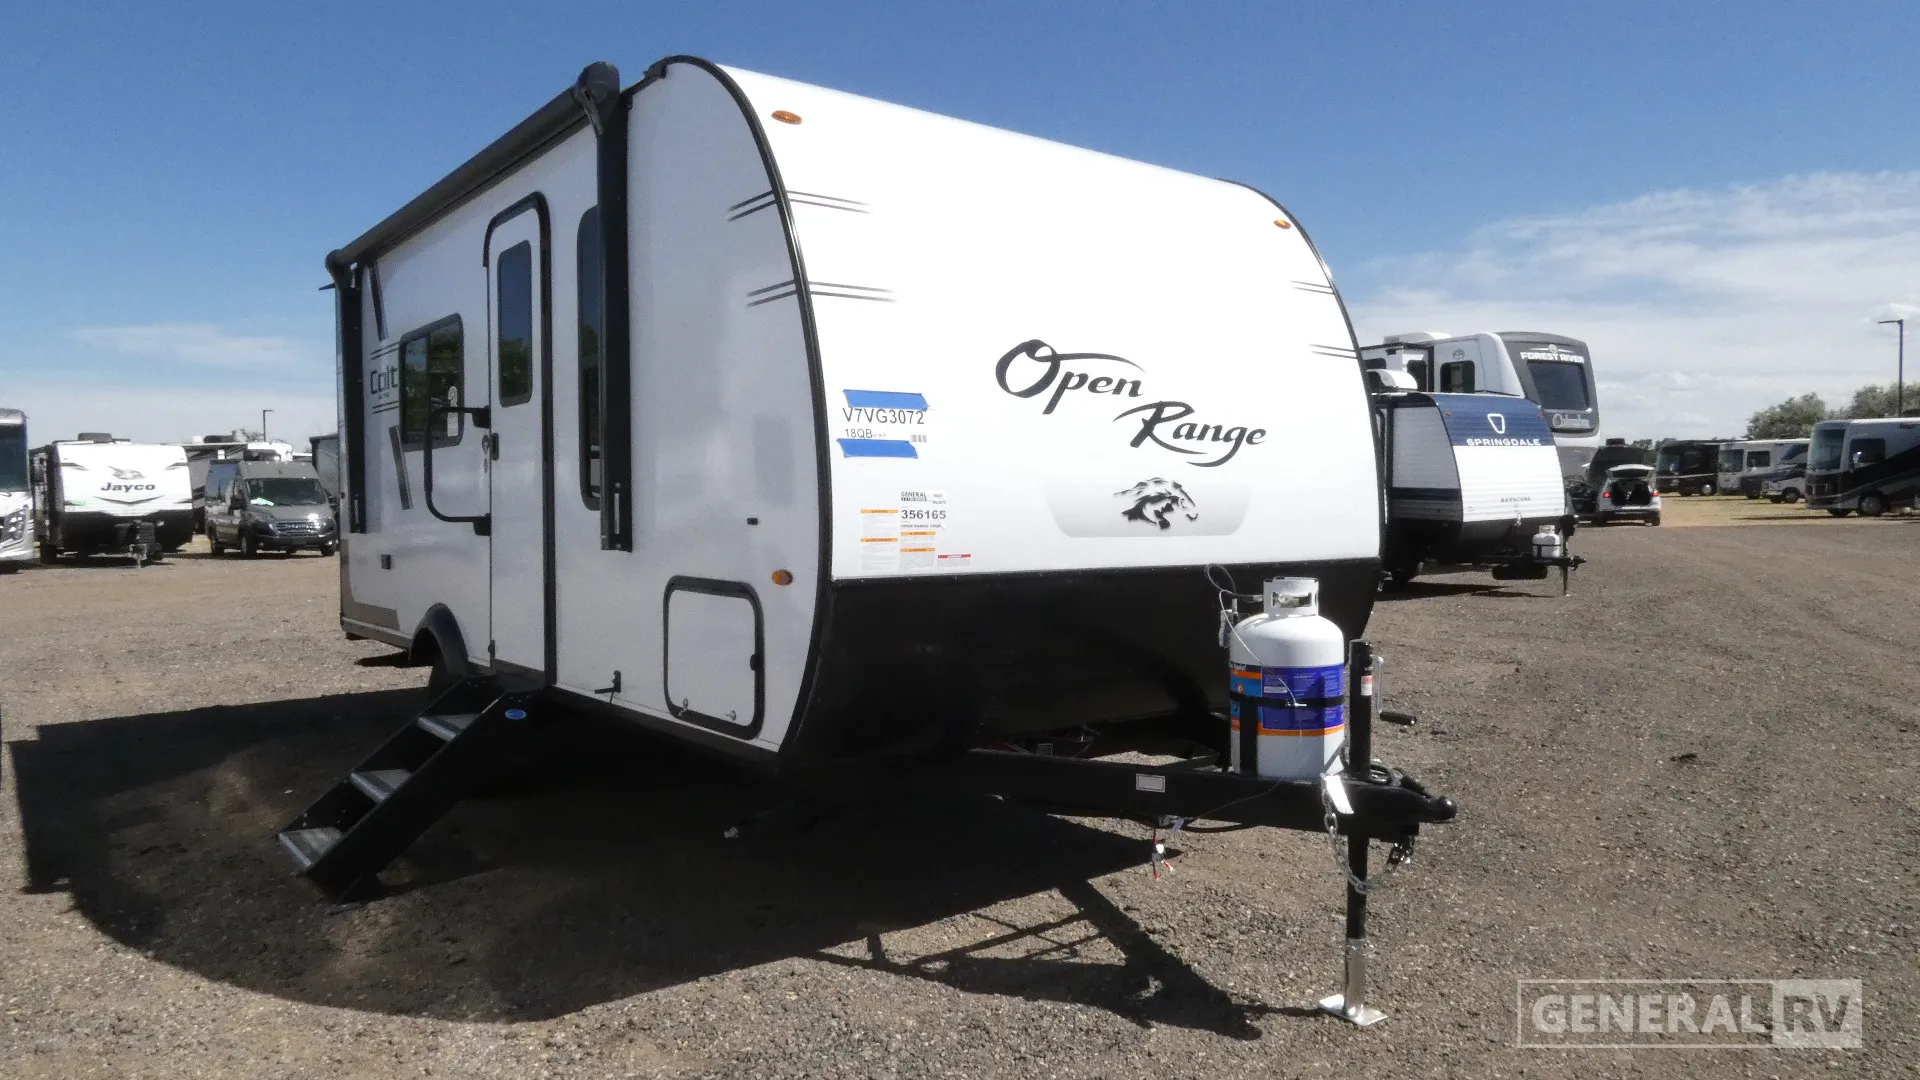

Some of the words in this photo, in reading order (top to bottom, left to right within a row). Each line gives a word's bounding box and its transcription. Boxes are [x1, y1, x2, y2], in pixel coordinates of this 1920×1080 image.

[1520, 352, 1559, 360] FOREST
[1560, 353, 1585, 364] RIVER
[995, 339, 1146, 414] Open
[842, 407, 925, 425] V7VG3072
[845, 428, 873, 440] 18QB
[1113, 400, 1267, 467] Range
[1466, 438, 1541, 446] SPRINGDALE
[100, 482, 156, 493] Jayco
[901, 509, 947, 520] 356165
